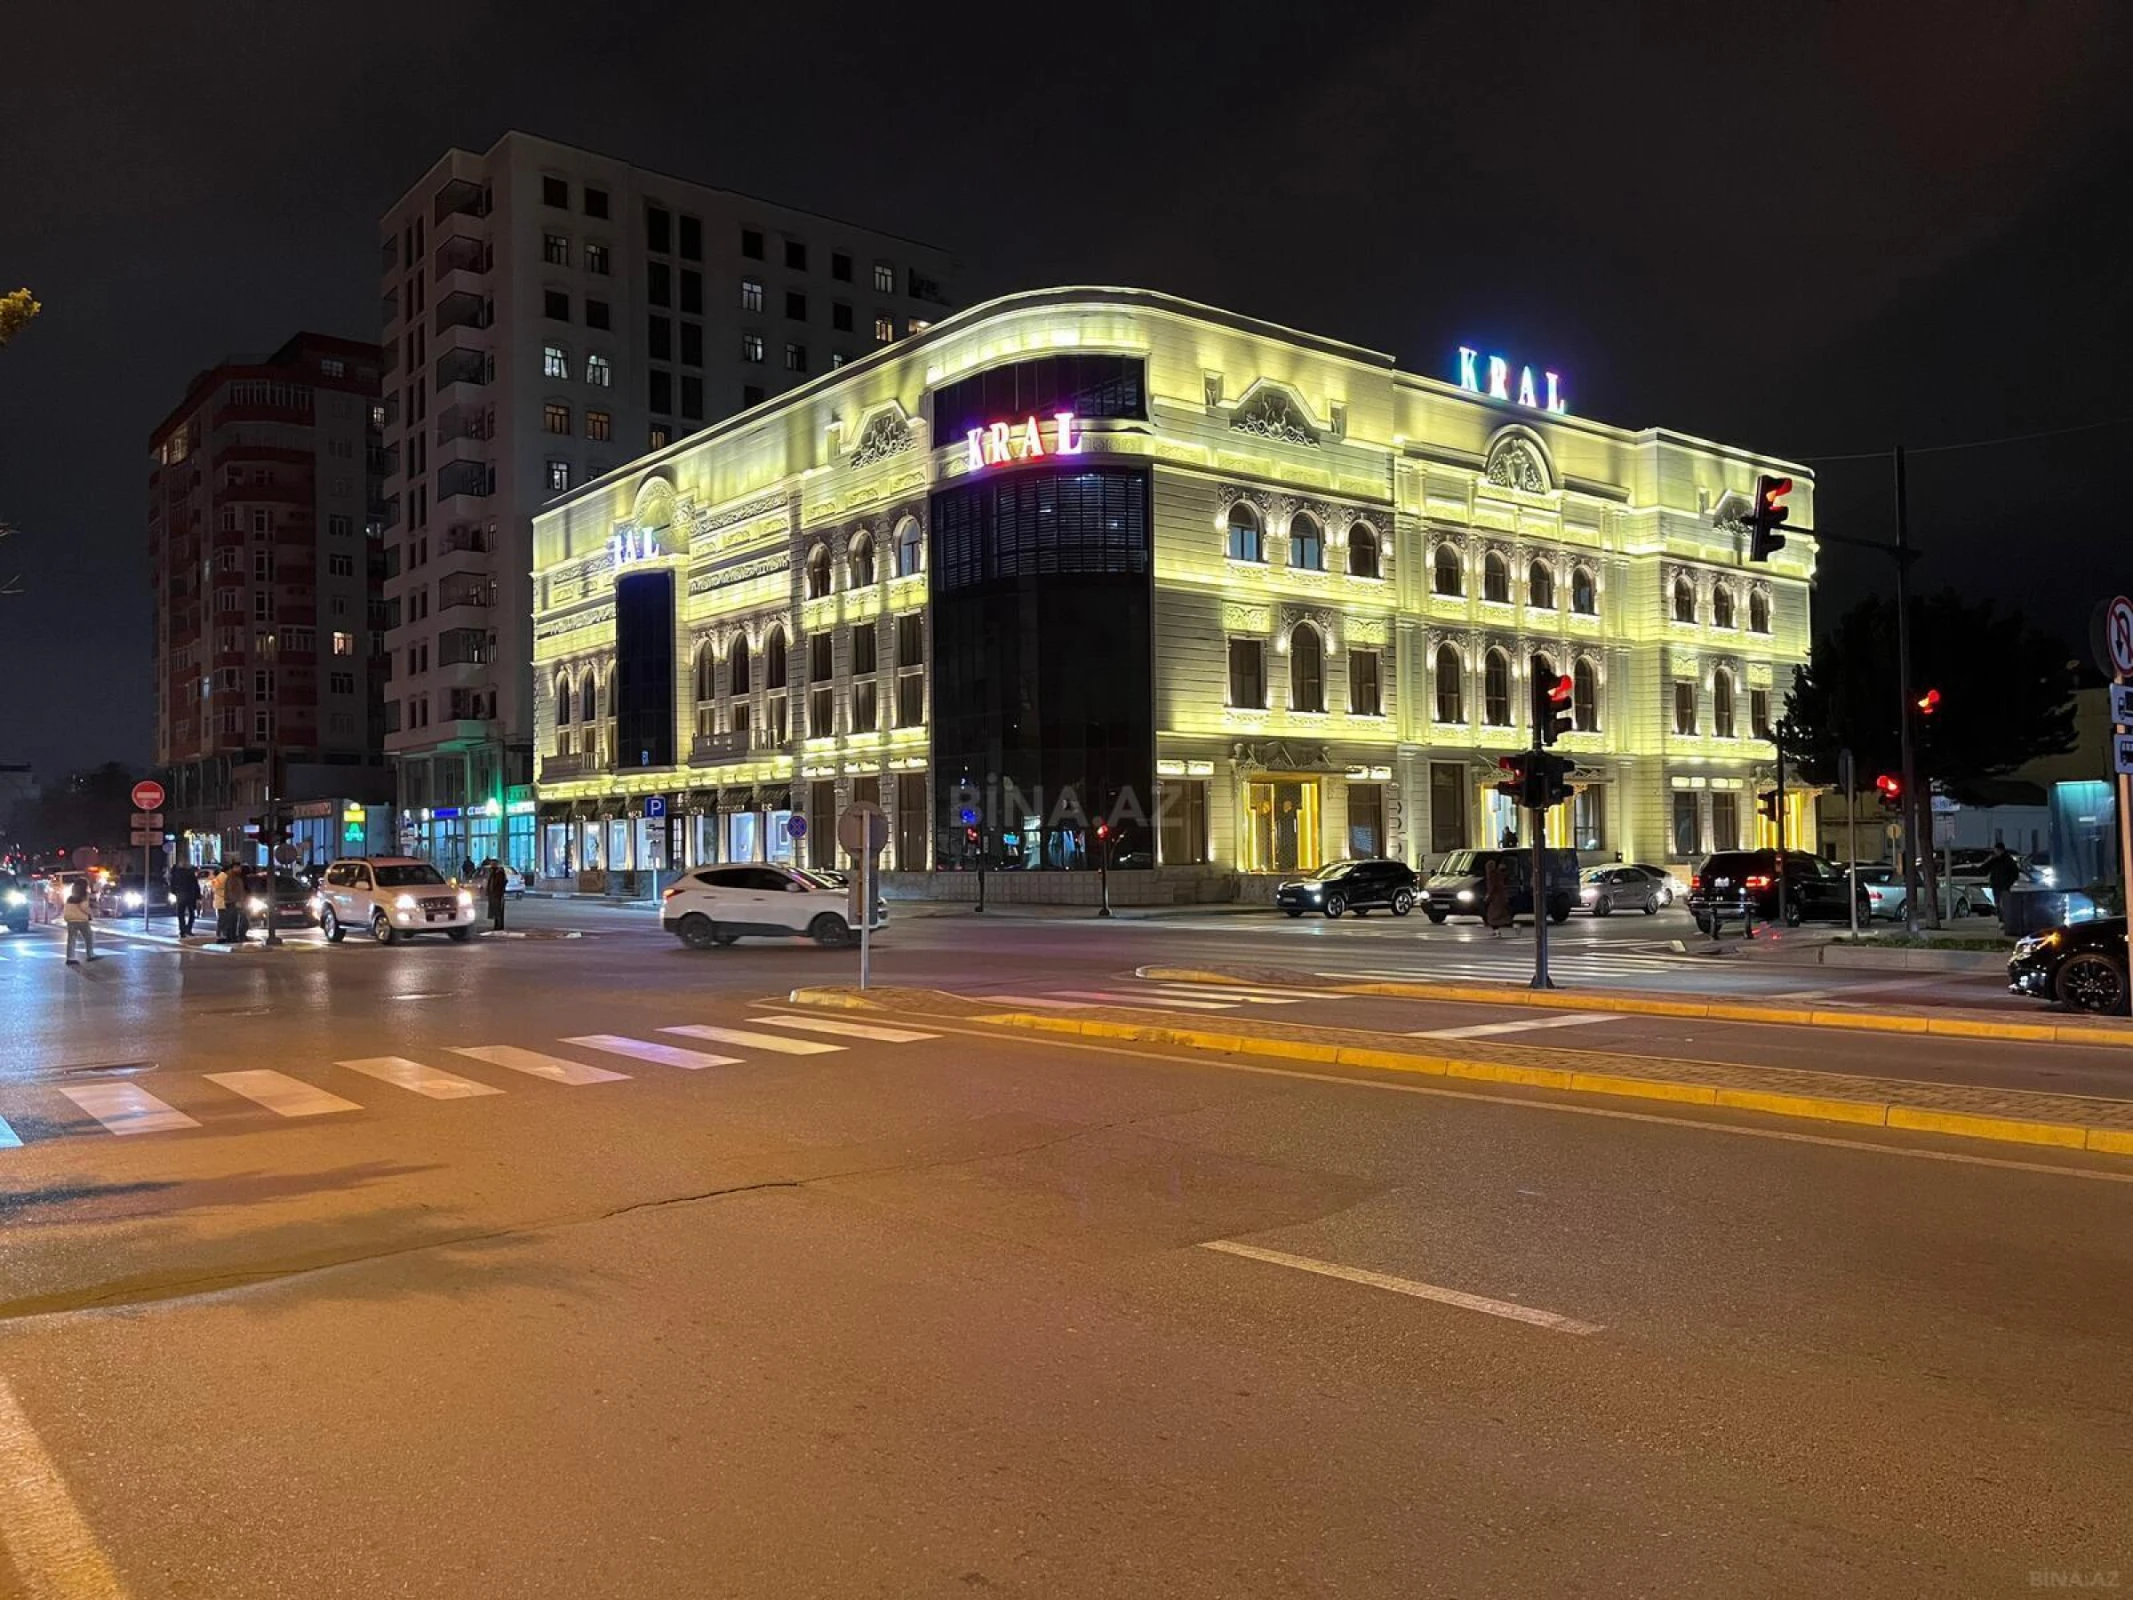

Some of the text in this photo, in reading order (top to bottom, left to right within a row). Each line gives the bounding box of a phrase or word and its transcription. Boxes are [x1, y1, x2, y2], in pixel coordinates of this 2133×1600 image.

[1459, 346, 1567, 415] KRAL
[967, 411, 1083, 471] KRAL
[650, 799, 662, 815] P
